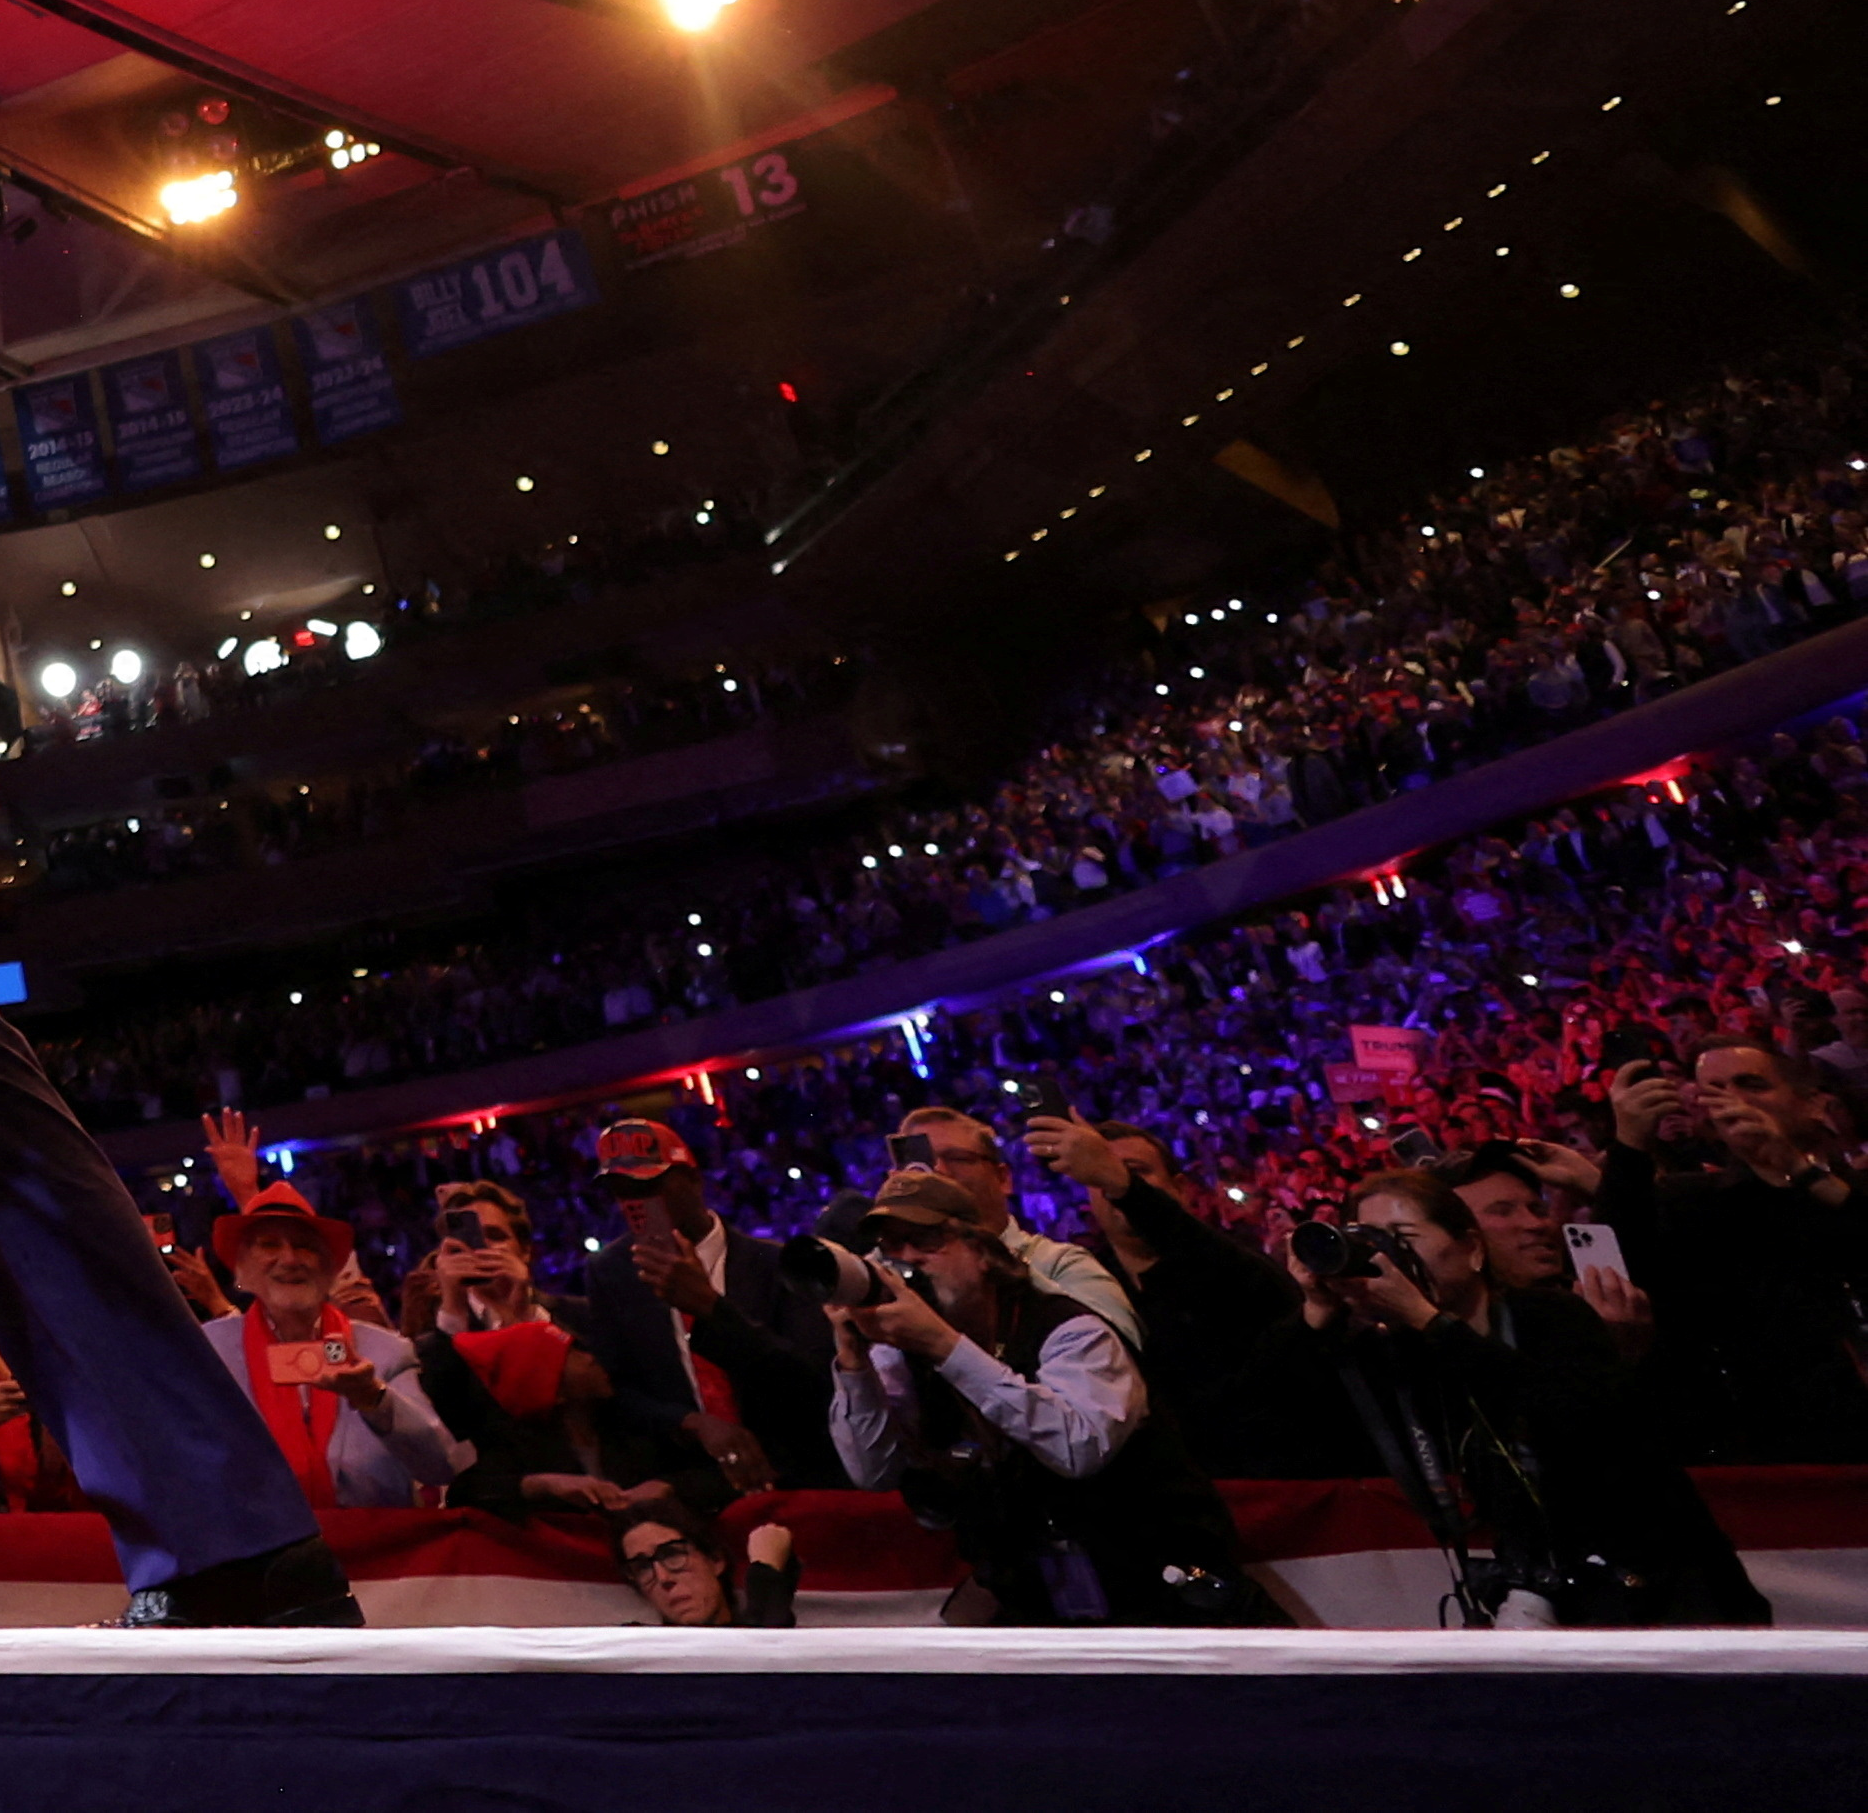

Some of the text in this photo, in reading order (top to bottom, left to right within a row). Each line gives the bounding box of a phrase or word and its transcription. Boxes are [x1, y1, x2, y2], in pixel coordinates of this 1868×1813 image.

[721, 152, 798, 216] 13
[411, 271, 462, 312] BILLY
[472, 239, 576, 319] 104
[424, 302, 472, 338] JOEL
[27, 430, 95, 461] 2014-15
